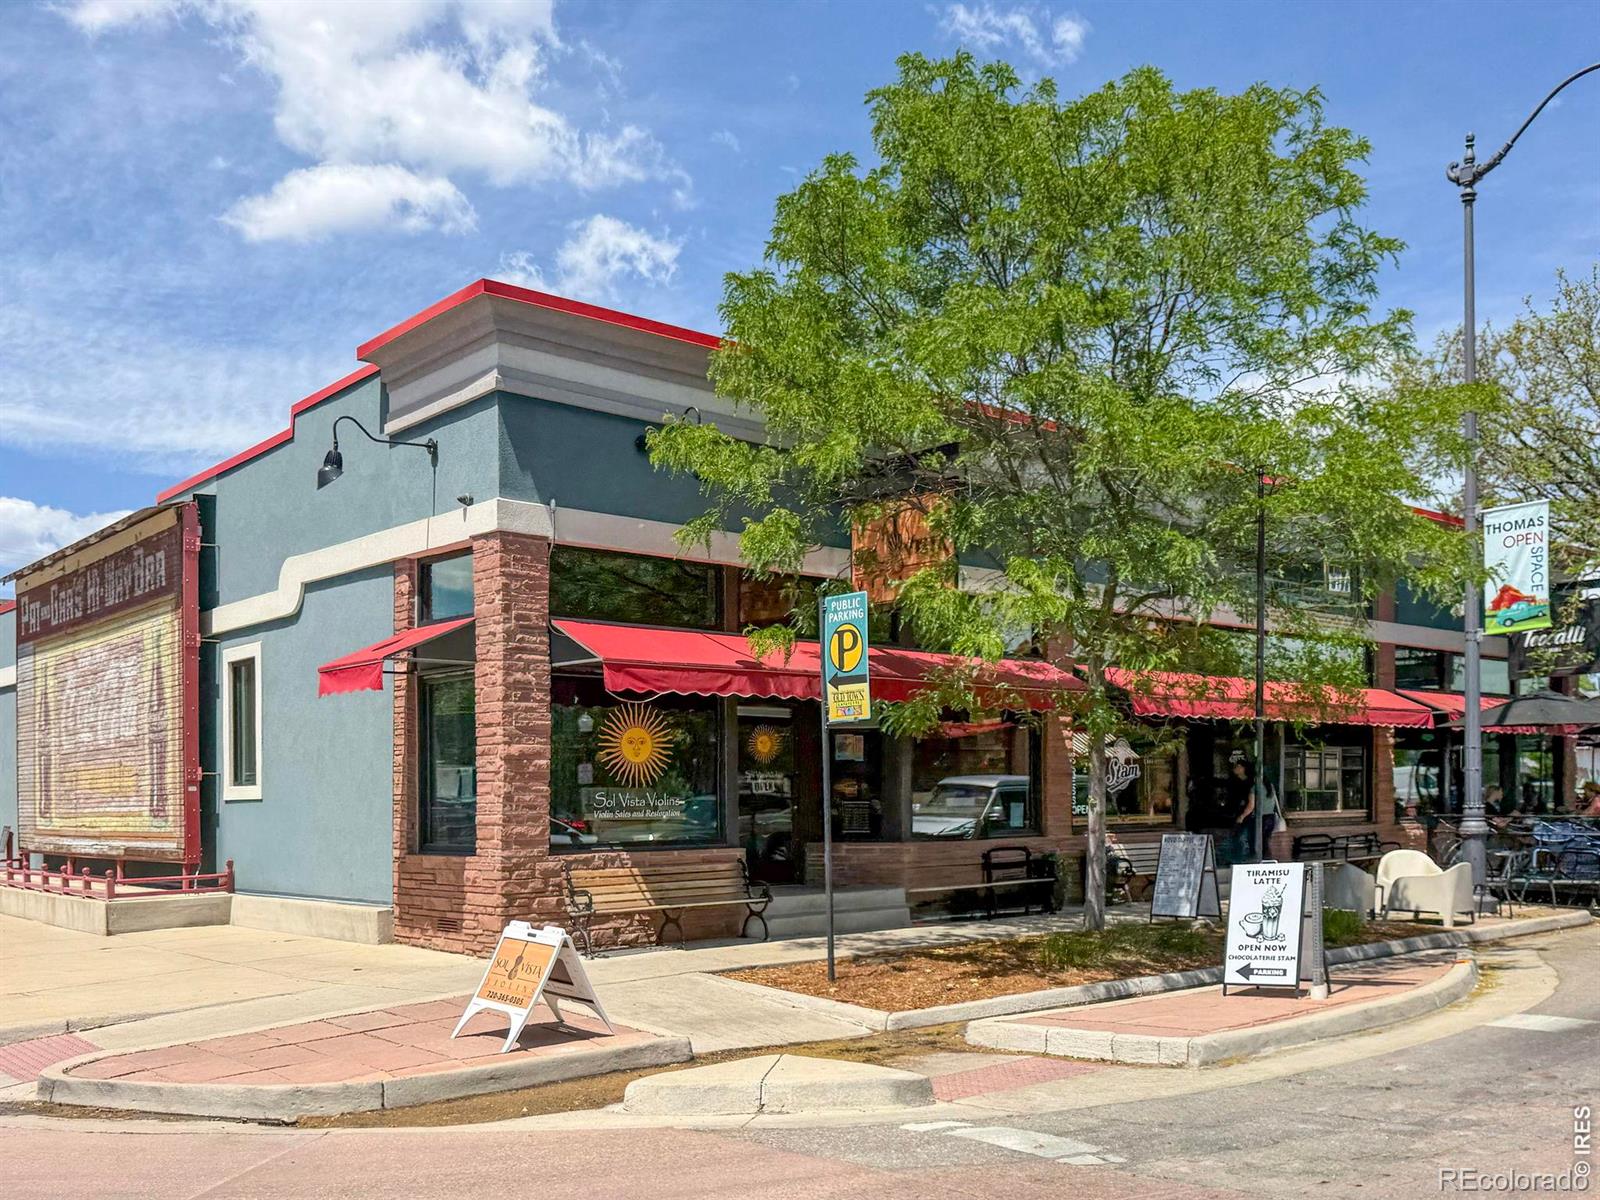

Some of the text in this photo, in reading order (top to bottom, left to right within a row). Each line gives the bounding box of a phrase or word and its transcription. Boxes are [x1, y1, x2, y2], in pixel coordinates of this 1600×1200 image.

[1486, 516, 1544, 535] THOMAS
[1503, 531, 1543, 549] OPEN
[1531, 547, 1544, 592] SPACE
[831, 597, 861, 611] PUBLIC
[828, 608, 864, 623] PARKING
[834, 629, 859, 671] P
[1105, 757, 1141, 786] Stam
[593, 792, 680, 808] Sol Vista Violins
[593, 809, 680, 818] Violin Sales and Restoration
[1247, 869, 1290, 877] TIRAMISU
[1254, 877, 1281, 885] LATTE
[496, 957, 542, 979] SOL VISTA
[1253, 968, 1284, 976] PARKING
